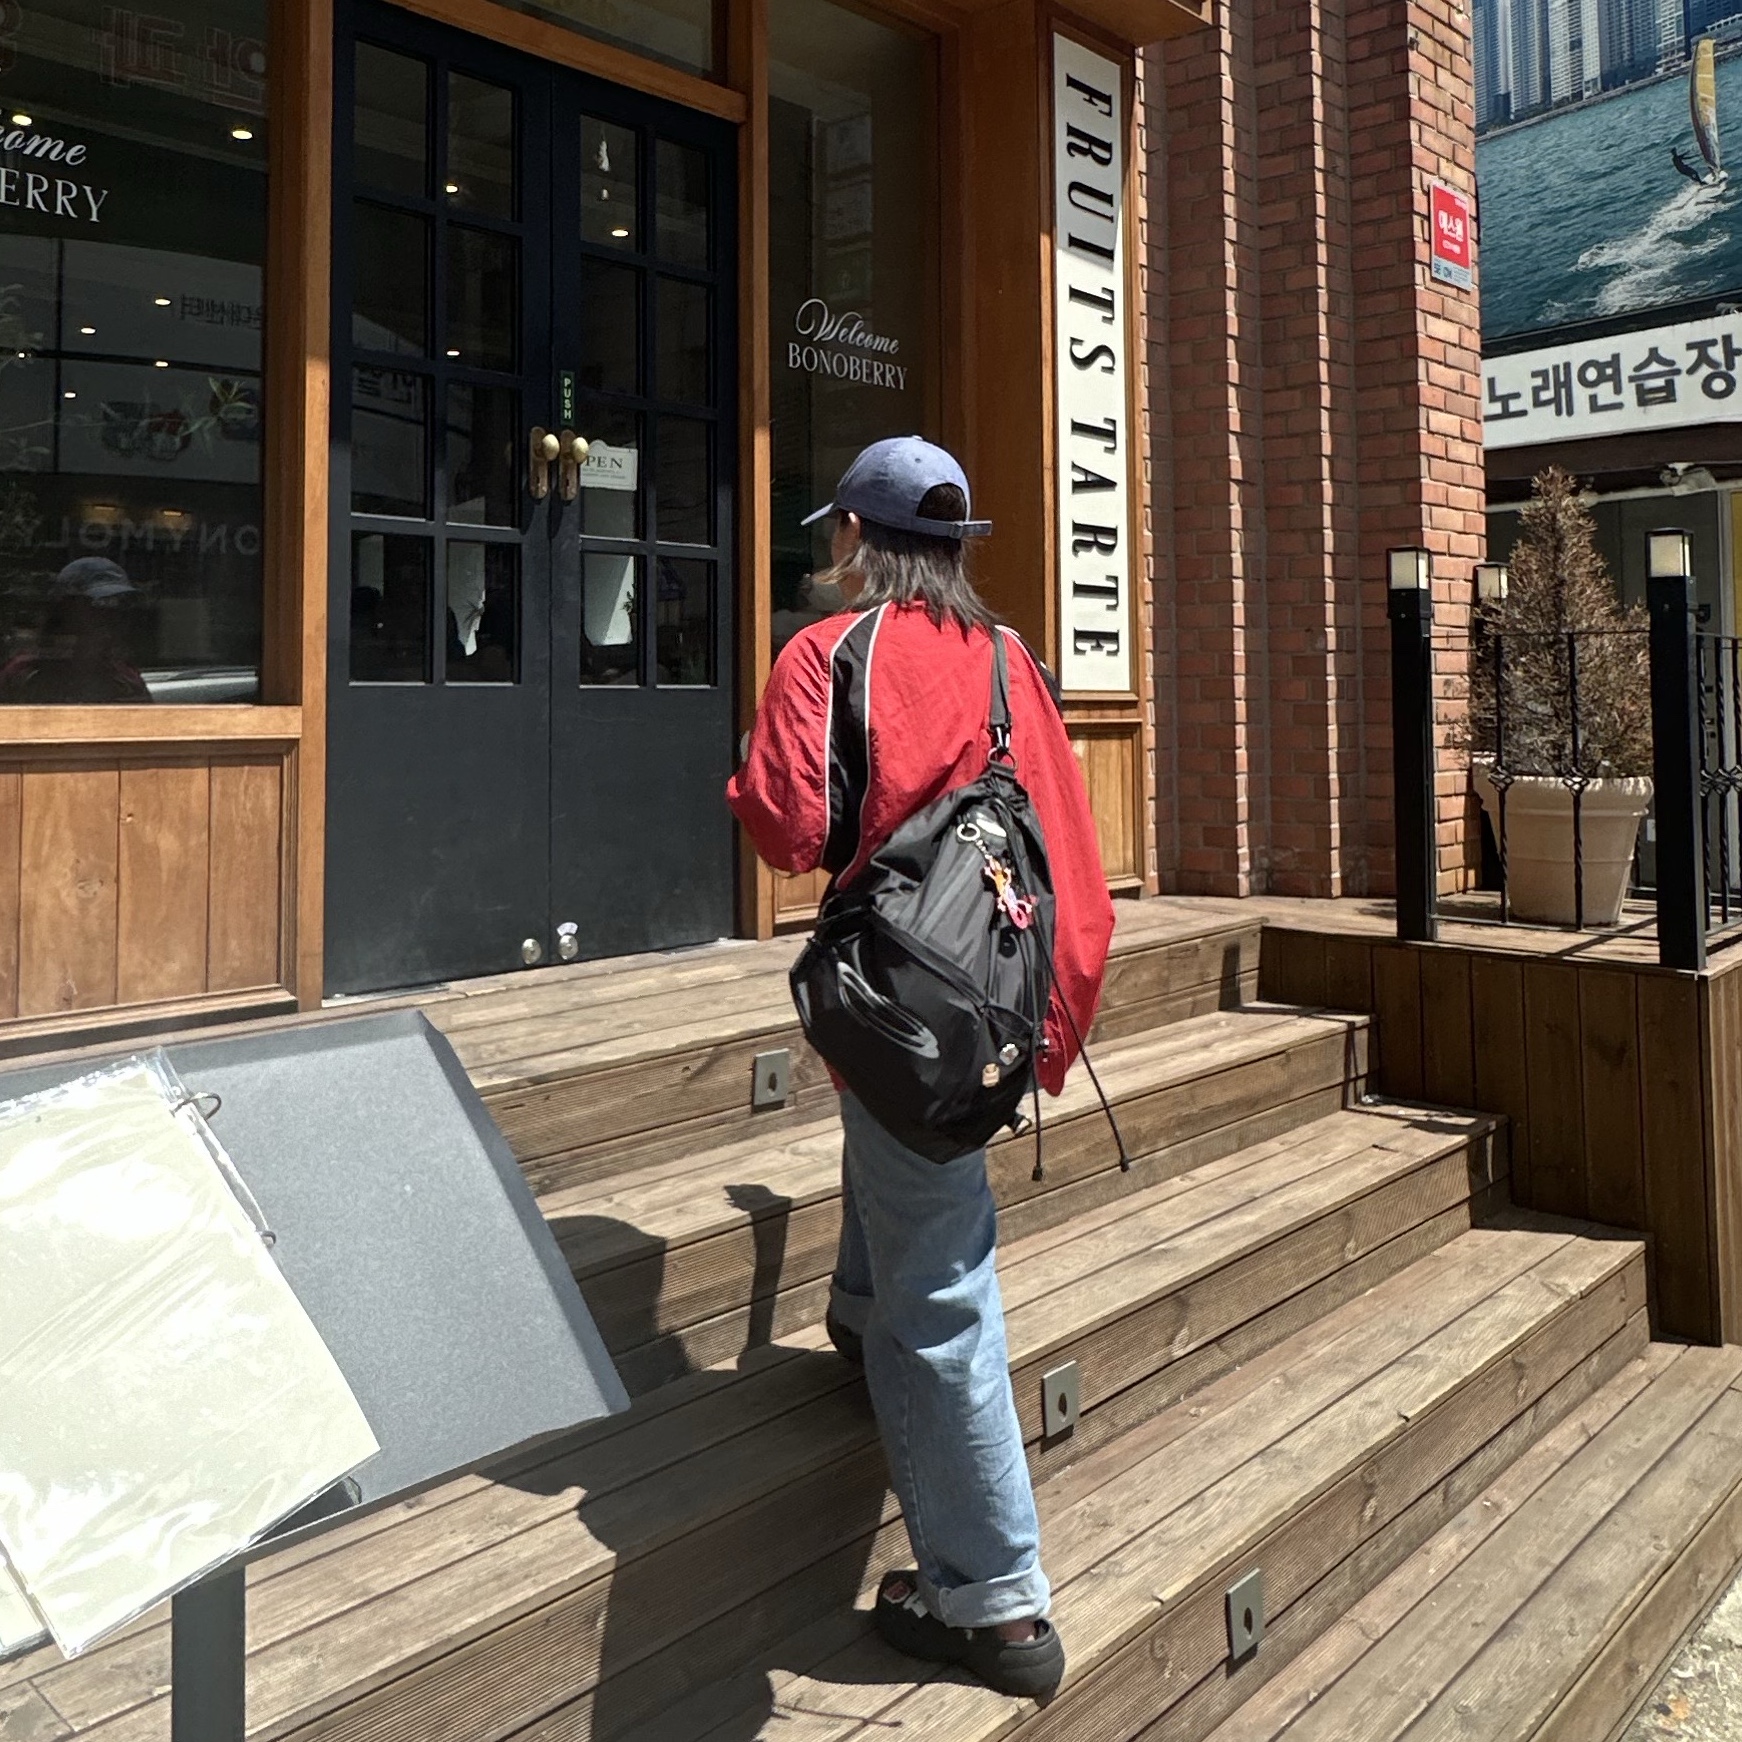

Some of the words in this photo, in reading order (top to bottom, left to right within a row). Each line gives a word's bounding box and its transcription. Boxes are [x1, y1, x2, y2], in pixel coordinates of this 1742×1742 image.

[0, 125, 87, 166] ome
[0, 167, 109, 223] ERRY
[1065, 73, 1116, 375] FRUITS
[795, 298, 900, 355] Welcome
[788, 342, 908, 391] BONOBERRY
[1484, 334, 1742, 422] 노래연습장
[563, 377, 573, 420] PUSH
[585, 454, 624, 469] PEN
[1070, 418, 1121, 658] TARTE
